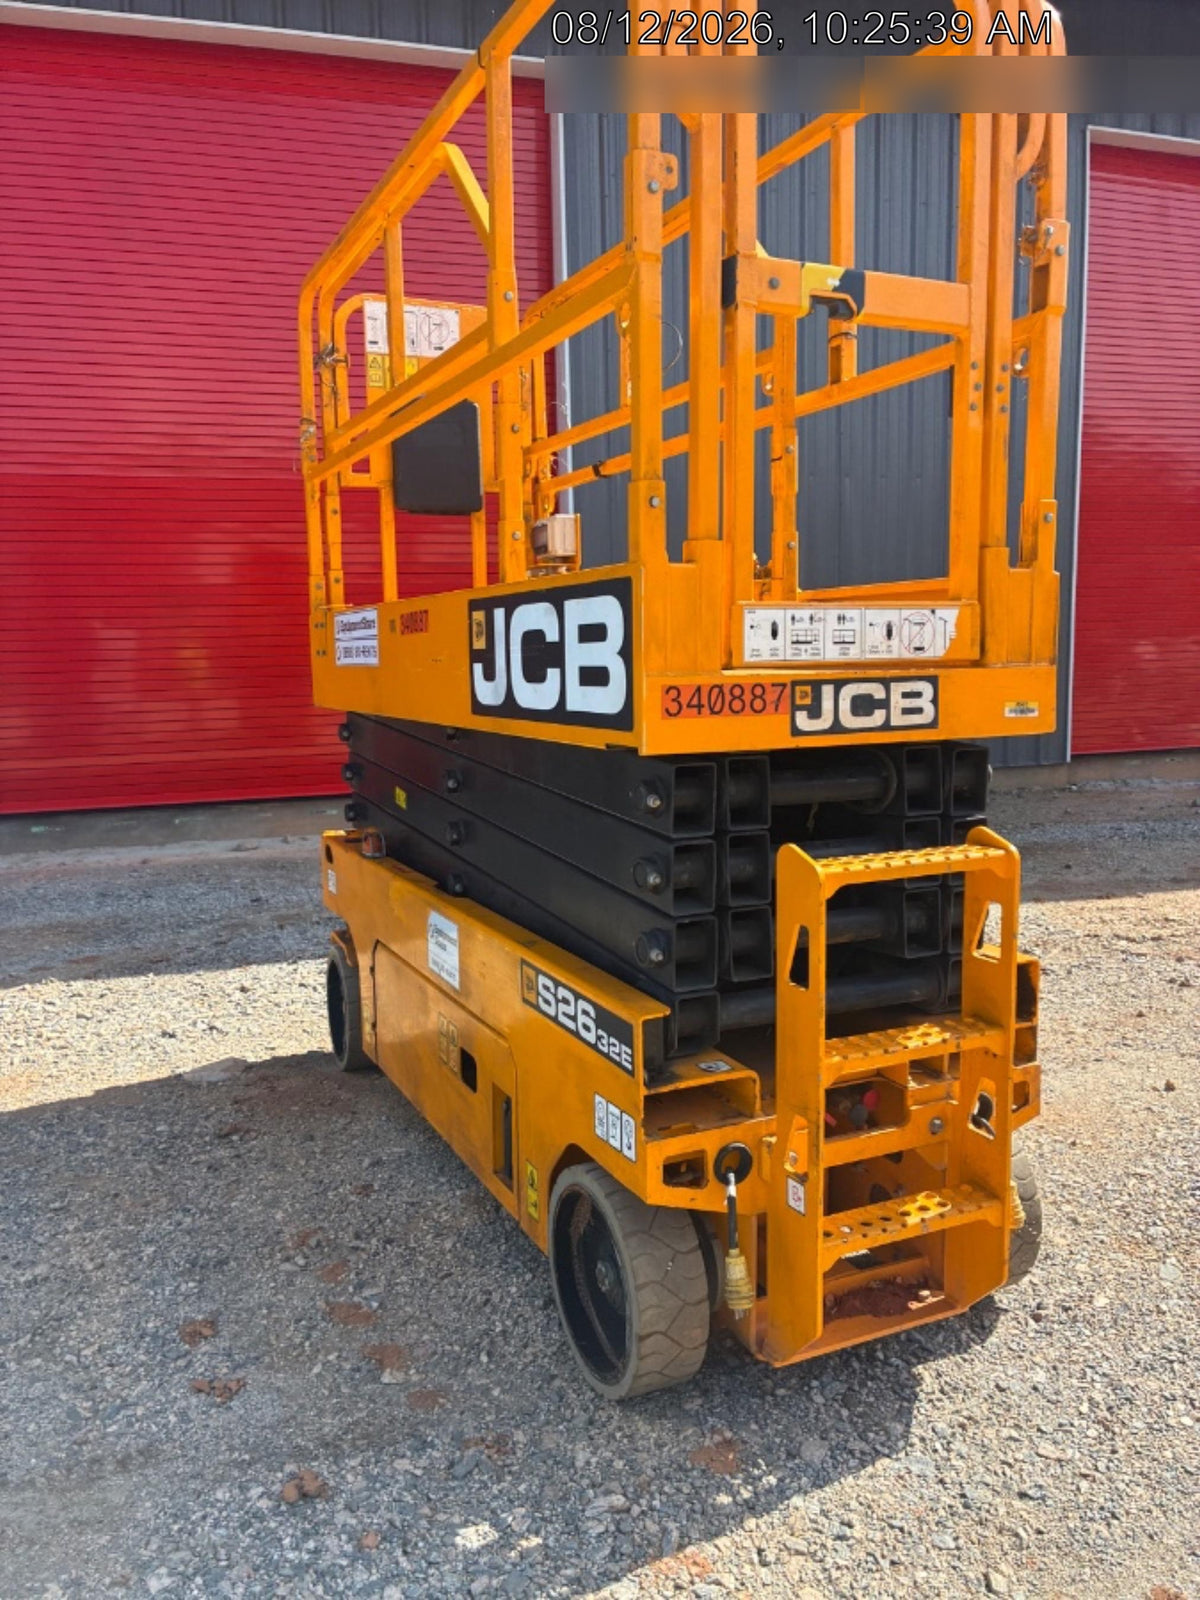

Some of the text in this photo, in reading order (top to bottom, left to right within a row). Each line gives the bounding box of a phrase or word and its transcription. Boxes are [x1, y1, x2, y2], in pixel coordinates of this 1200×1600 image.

[472, 595, 627, 715] JCB
[664, 682, 788, 717] 340887
[794, 680, 935, 731] JCB
